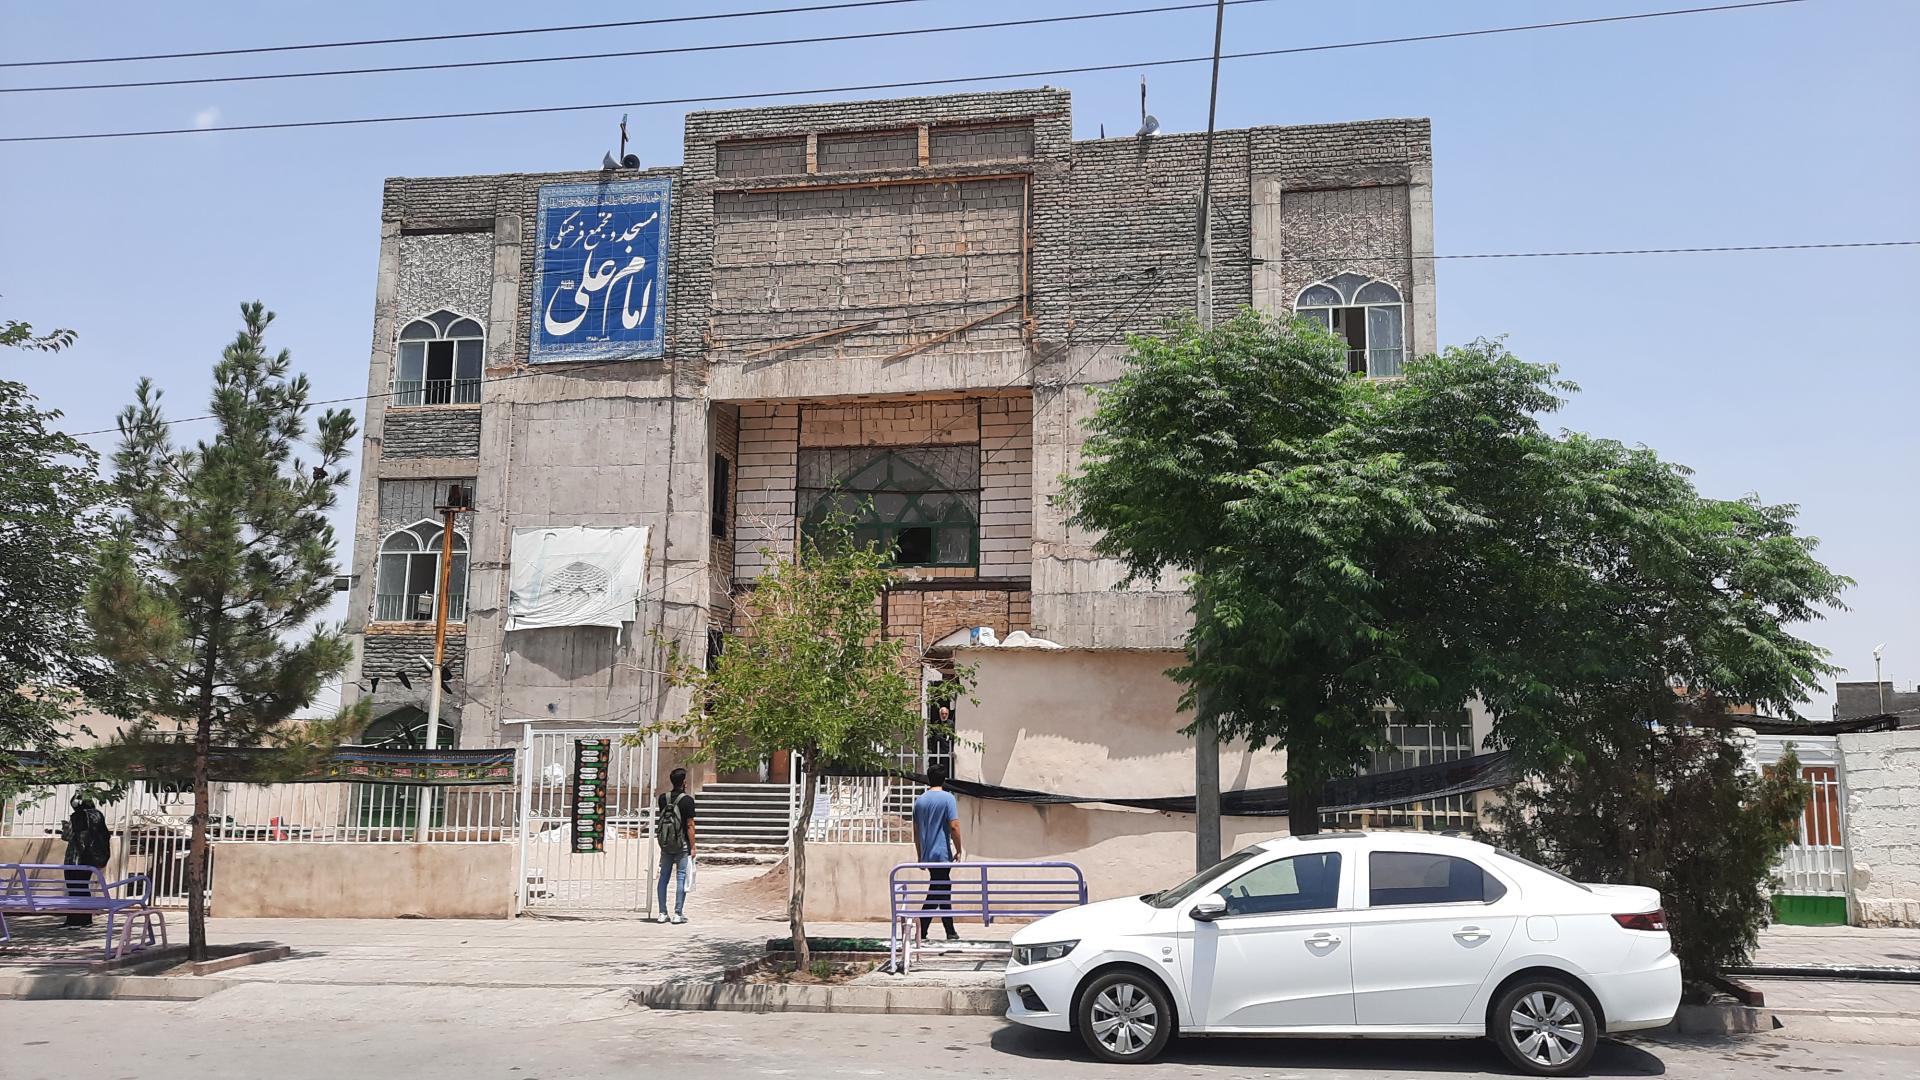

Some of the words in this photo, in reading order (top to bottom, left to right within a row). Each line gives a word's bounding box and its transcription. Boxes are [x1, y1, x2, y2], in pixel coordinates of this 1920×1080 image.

[549, 210, 584, 250] فرهنگی
[584, 212, 612, 250] مجتمع
[609, 231, 616, 241] و
[615, 211, 658, 253] مسجد
[544, 250, 617, 336] علی
[602, 256, 652, 336] امام
